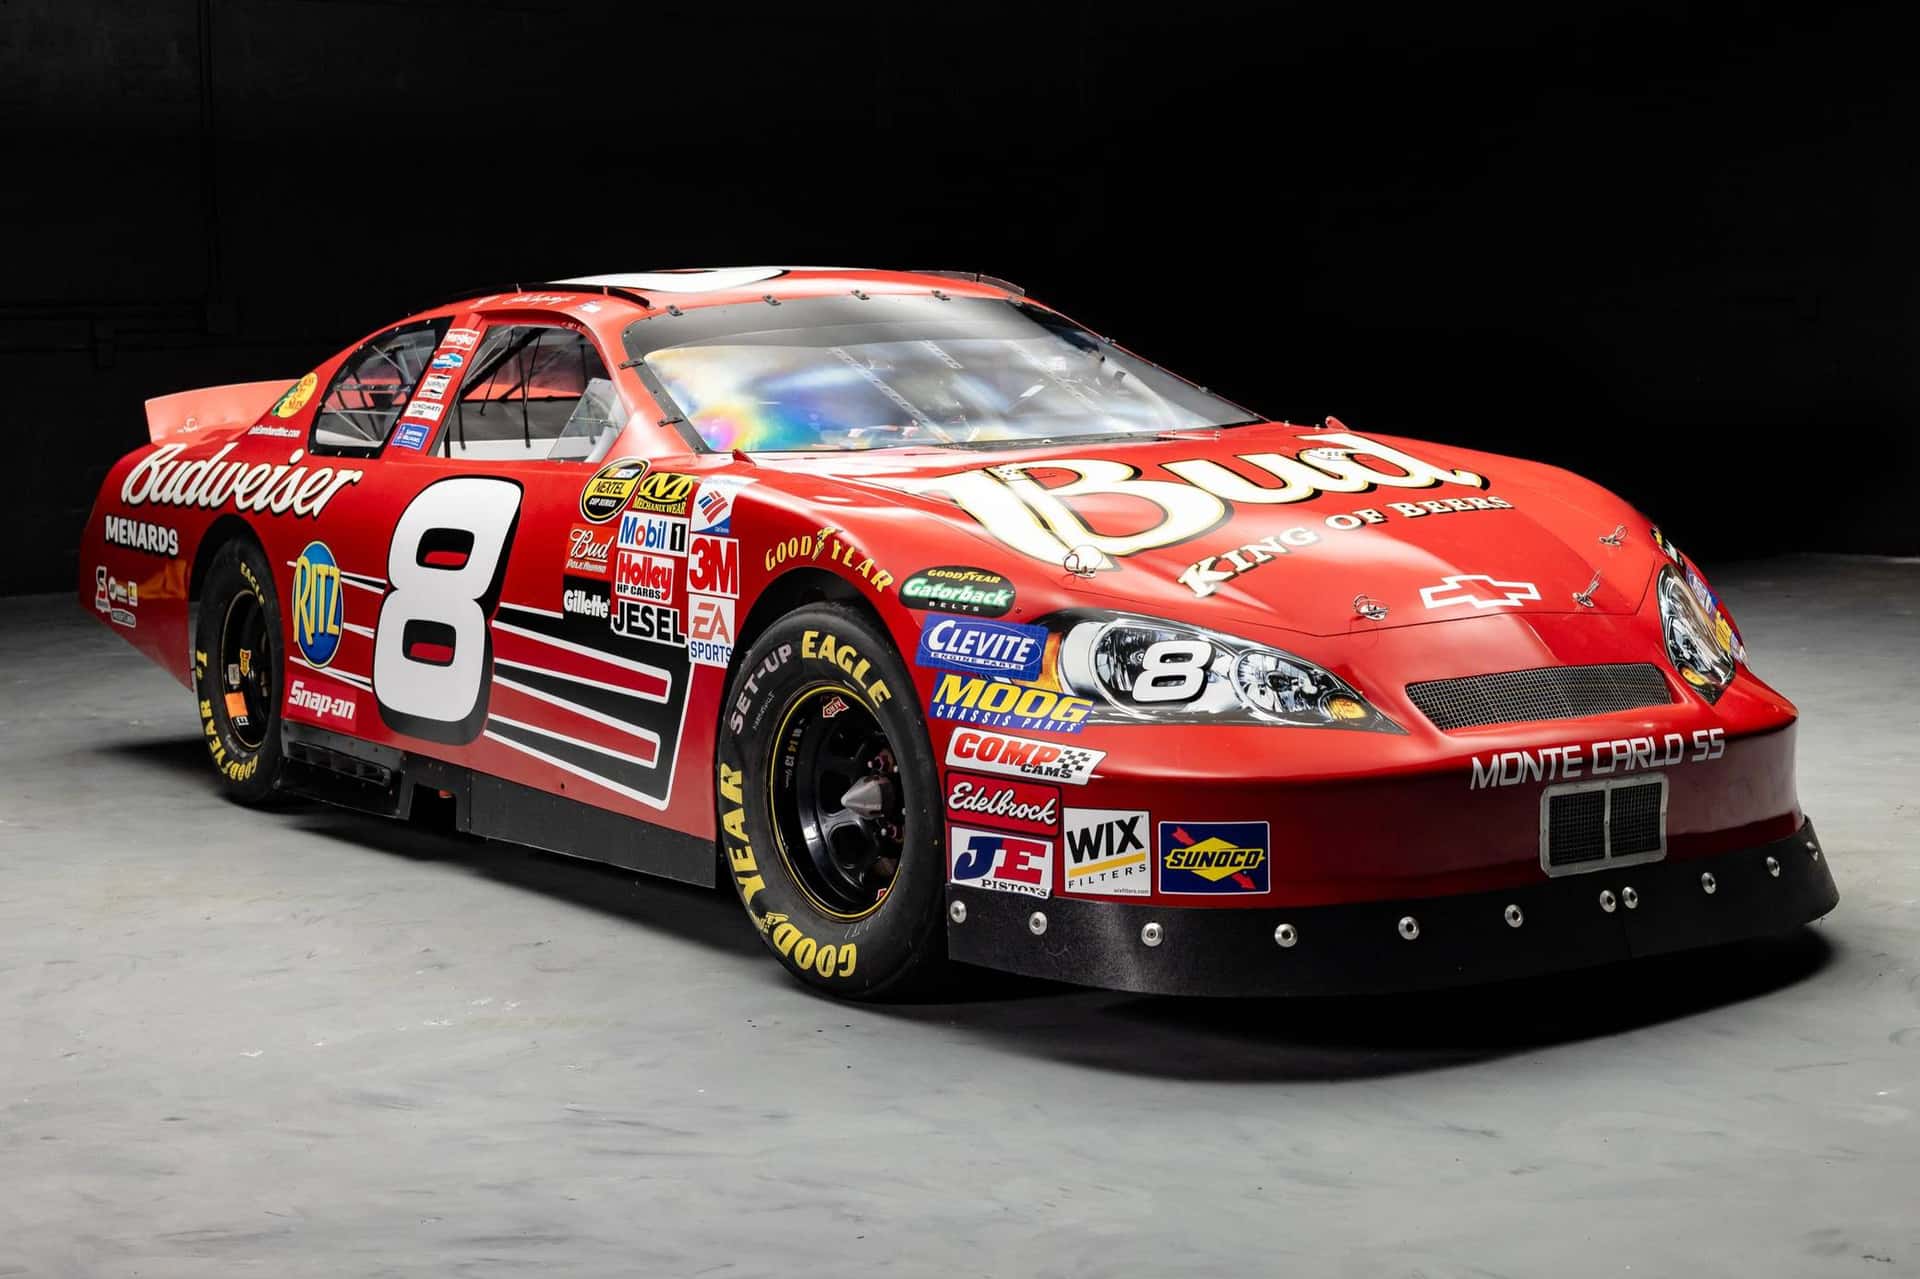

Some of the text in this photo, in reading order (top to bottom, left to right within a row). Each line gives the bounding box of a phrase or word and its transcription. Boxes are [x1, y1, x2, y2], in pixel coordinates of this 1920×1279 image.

[121, 443, 363, 516] Budweiser
[593, 481, 625, 495] NEXTEL
[666, 501, 686, 514] WEAR
[915, 434, 1486, 569] Bud
[105, 515, 179, 556] MENARDS
[570, 528, 615, 560] Bud
[621, 516, 667, 550] Mobil
[1173, 495, 1514, 598] KING OF BEERS
[618, 554, 673, 600] Holley
[689, 538, 736, 596] 3M
[928, 569, 1001, 584] GOODYEAR
[294, 556, 340, 645] RITZ
[373, 475, 524, 740] 8
[564, 589, 610, 619] Gillette
[617, 583, 661, 599] HP CARBS
[903, 578, 1013, 607] Gatorback
[929, 601, 980, 612] BELTS
[613, 602, 686, 645] JESEL
[693, 603, 730, 643] EA
[928, 620, 1035, 662] CLEVITE
[690, 641, 732, 664] SPORTS
[801, 630, 892, 712] EAGLE
[932, 652, 1024, 670] ENGINE PARTS
[1131, 640, 1216, 703] 8
[288, 680, 356, 720] Snap-on
[731, 643, 792, 735] SET-UP
[933, 674, 1094, 723] MOOG
[936, 704, 1079, 733] CHASSIS PARTS
[954, 733, 1062, 768] COMP
[1470, 728, 1725, 791] MONTE CARLO SS
[1020, 763, 1072, 779] CAMS
[948, 781, 1056, 825] Edelbrock
[1066, 816, 1144, 864] WIX
[1168, 849, 1266, 868] SUNOCO
[954, 836, 1047, 885] JE
[1068, 863, 1147, 889] FILTERS
[981, 879, 1048, 897] PISTONS
